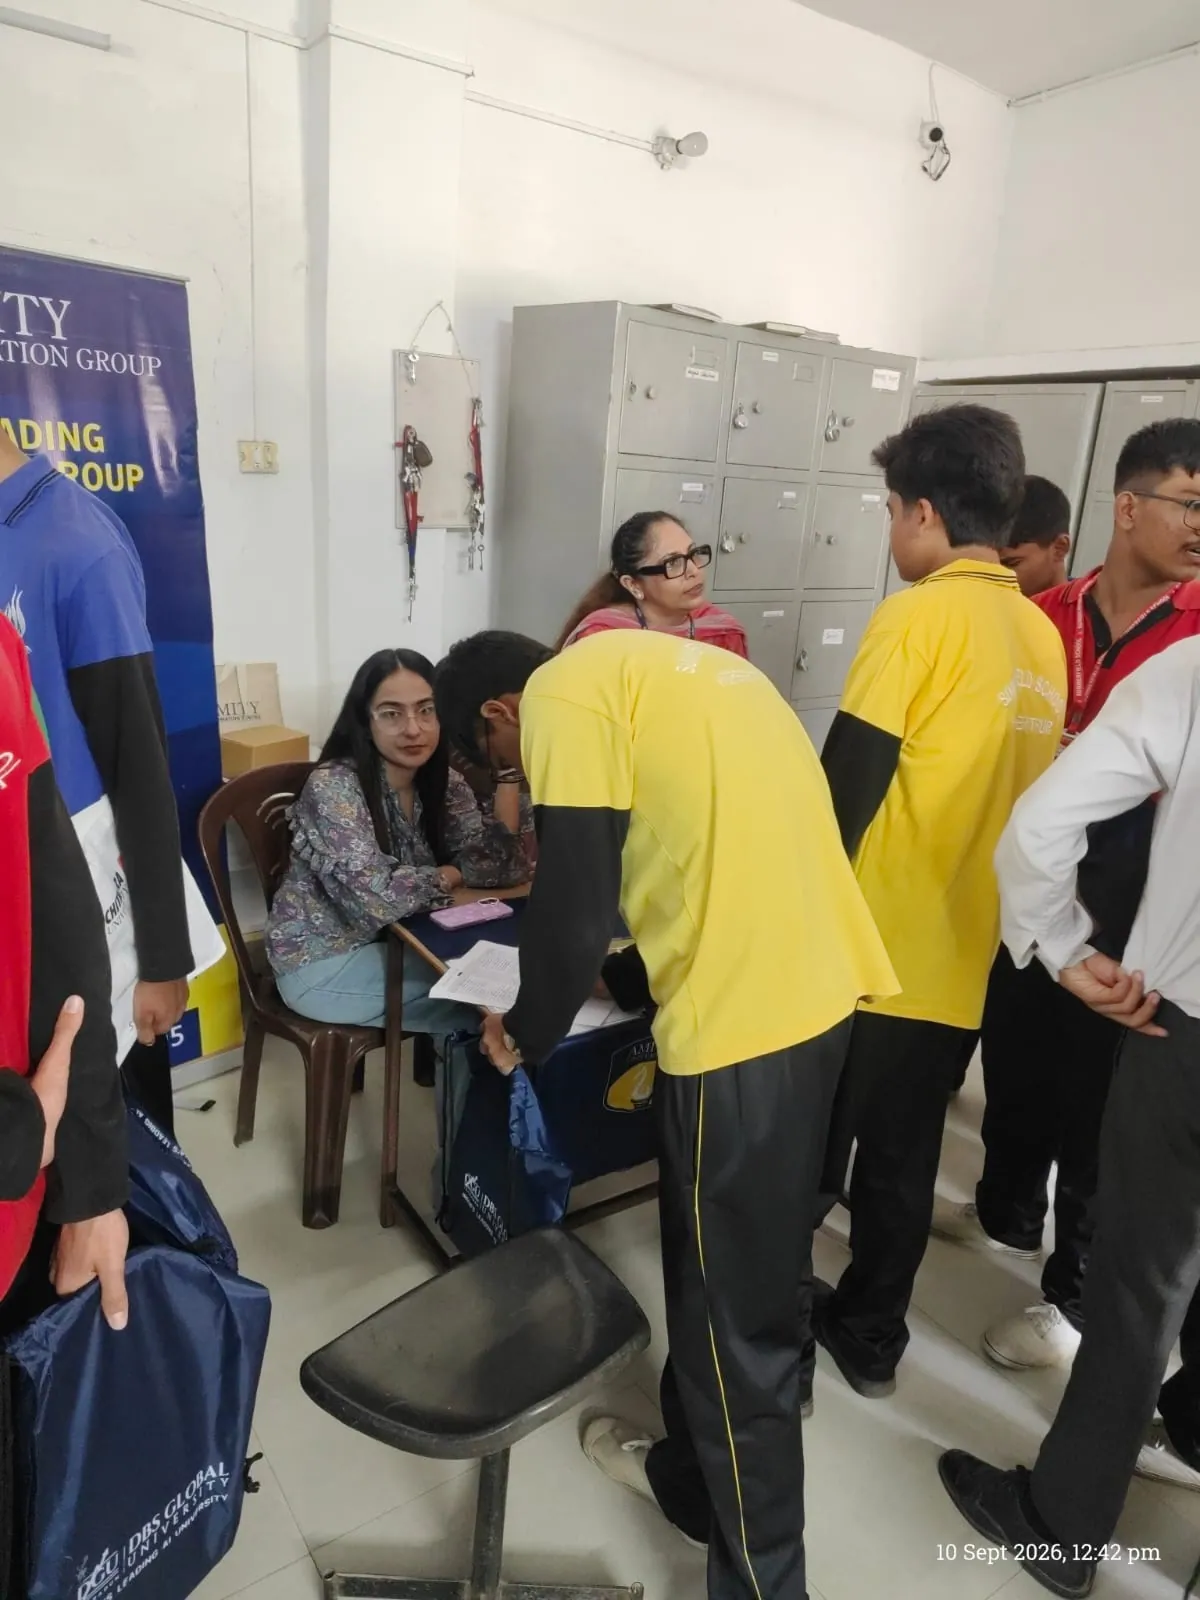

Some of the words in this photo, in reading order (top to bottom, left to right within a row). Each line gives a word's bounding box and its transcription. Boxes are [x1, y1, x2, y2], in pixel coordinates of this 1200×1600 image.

[0, 291, 71, 340] TY
[0, 339, 69, 368] TION
[76, 348, 162, 377] GROUP
[166, 1024, 185, 1047] 5
[127, 1477, 230, 1566] UNIVERSITY
[128, 1513, 160, 1554] DBS
[164, 1461, 230, 1520] GLOBAL
[116, 1549, 159, 1593] LEADING
[162, 1536, 172, 1550] AI
